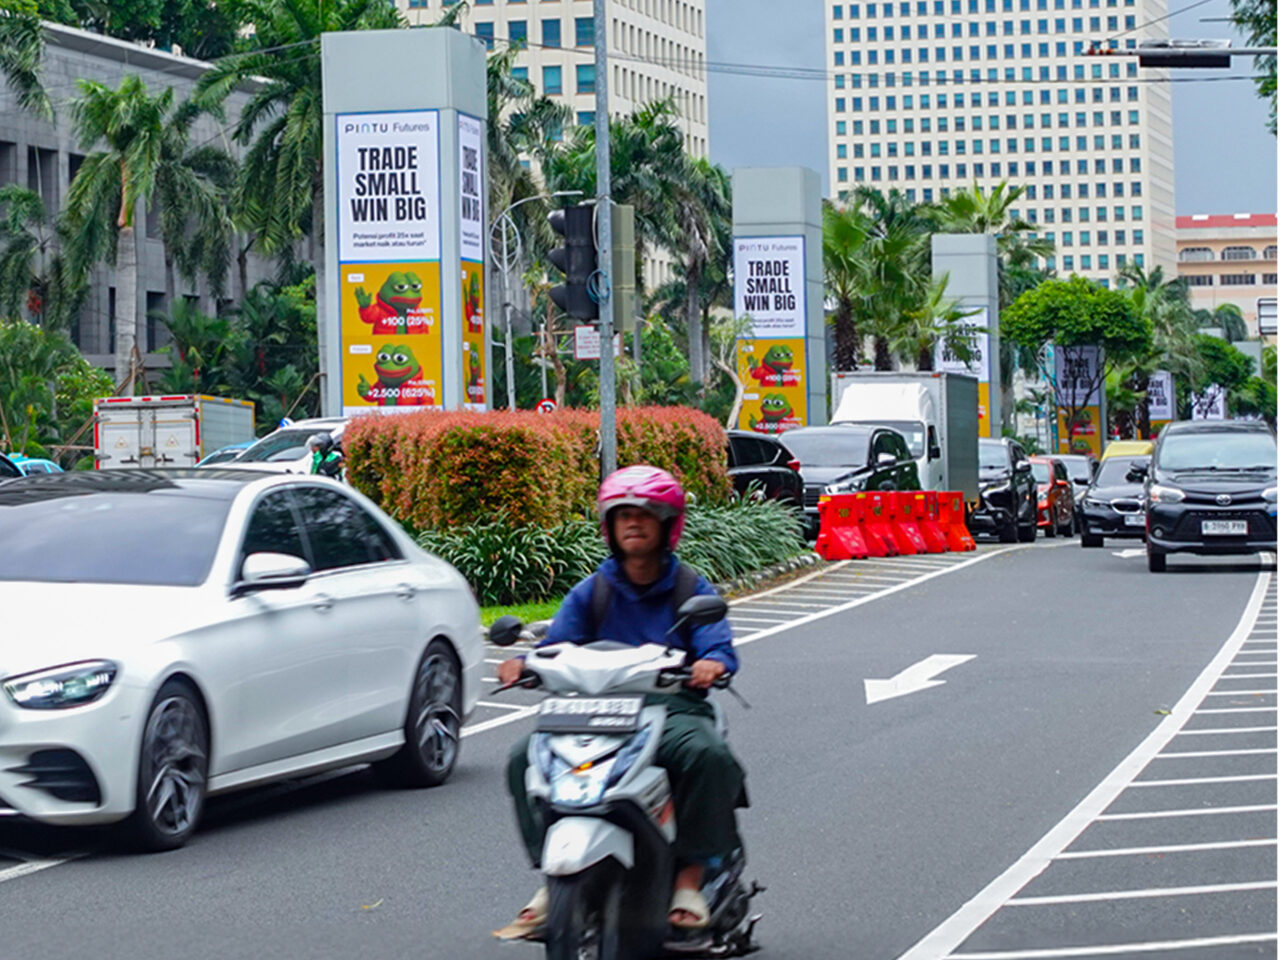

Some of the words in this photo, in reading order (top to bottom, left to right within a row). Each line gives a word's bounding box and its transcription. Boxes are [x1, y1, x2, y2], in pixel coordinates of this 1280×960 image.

[345, 123, 388, 133] PINTU
[393, 122, 430, 132] Futures
[357, 146, 417, 170] TRADE
[355, 172, 421, 196] SMALL
[351, 198, 387, 222] WIN
[395, 197, 426, 221] BIG
[748, 260, 789, 276] TRADE
[746, 278, 792, 294] SMALL
[743, 295, 769, 311] WIN
[774, 294, 796, 311] BIG
[382, 316, 405, 326] +100
